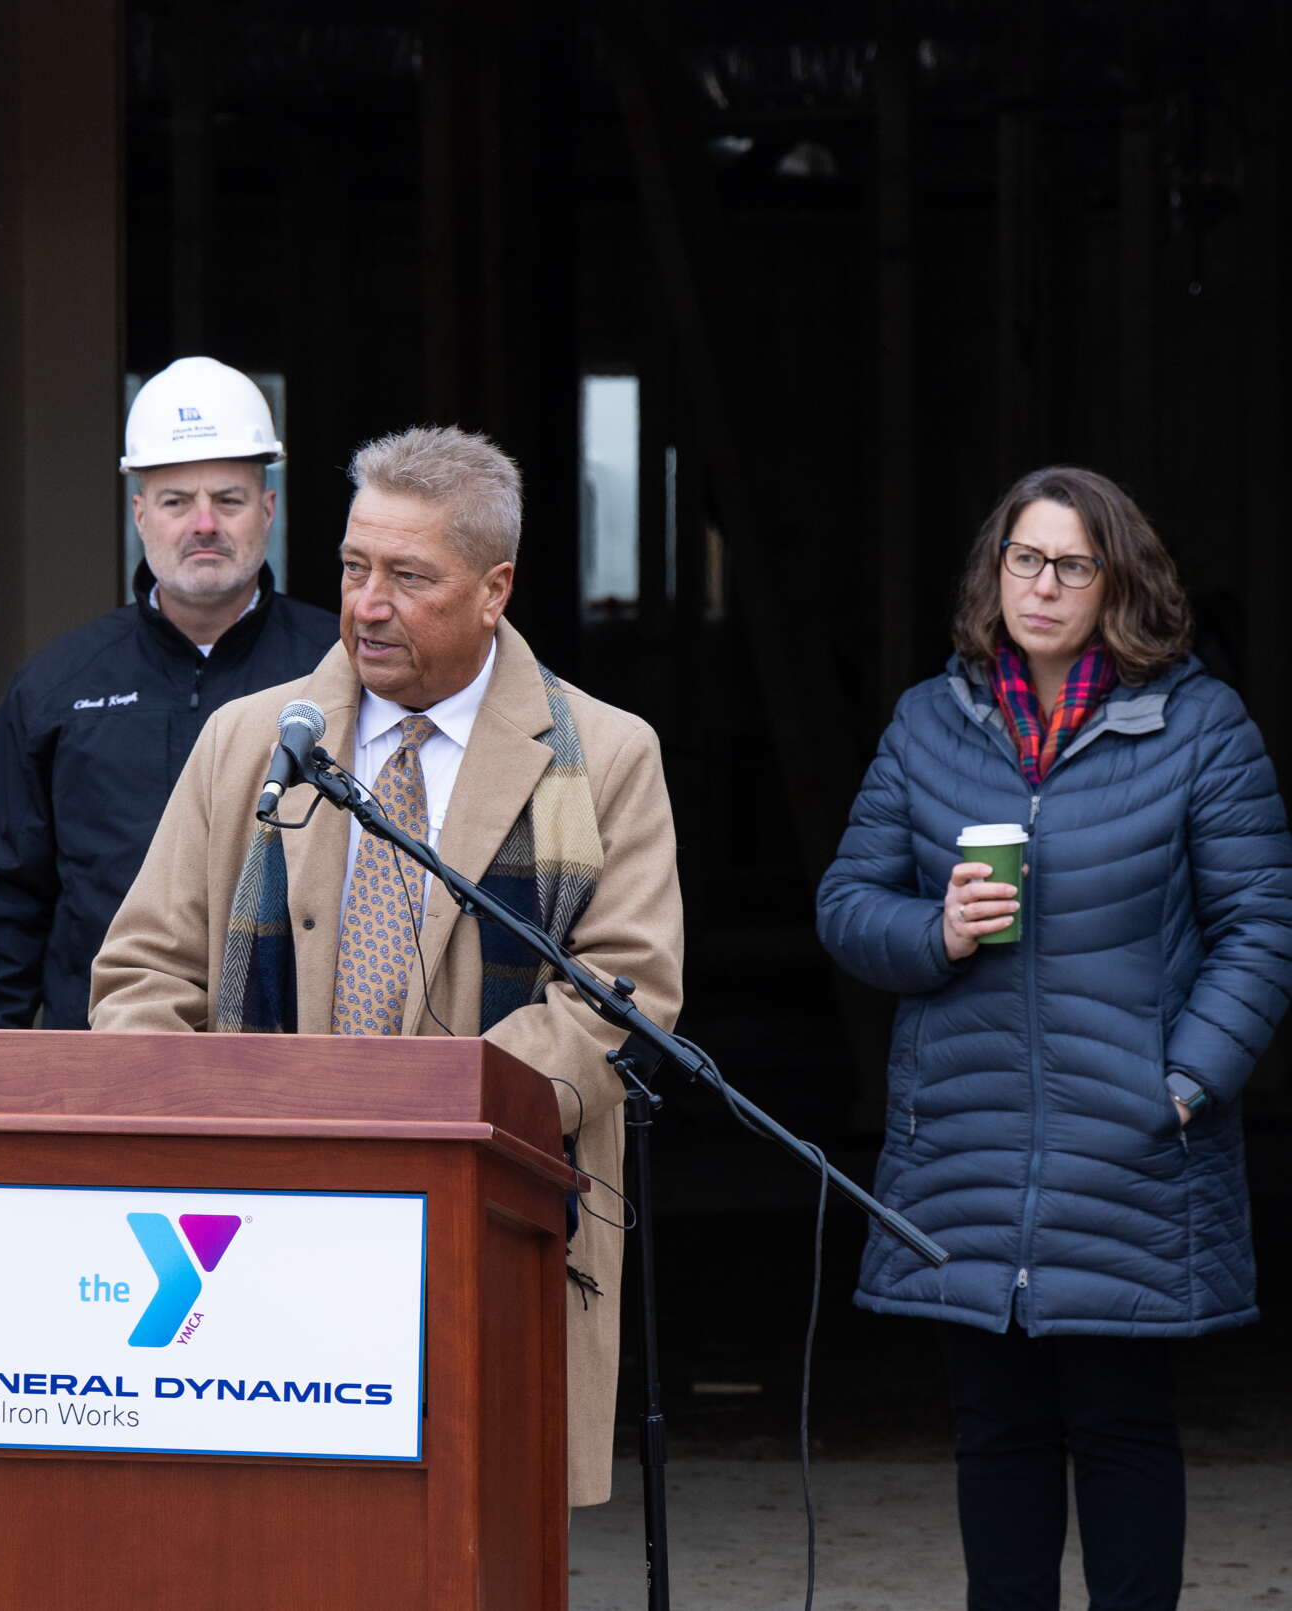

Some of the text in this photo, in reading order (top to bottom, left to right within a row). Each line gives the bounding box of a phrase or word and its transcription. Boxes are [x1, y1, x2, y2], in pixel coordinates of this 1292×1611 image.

[79, 1273, 131, 1303] the
[176, 1312, 205, 1346] YMCA
[154, 1377, 393, 1406] DYNAMICS
[2, 1400, 48, 1424] Iron
[57, 1402, 140, 1428] Works
